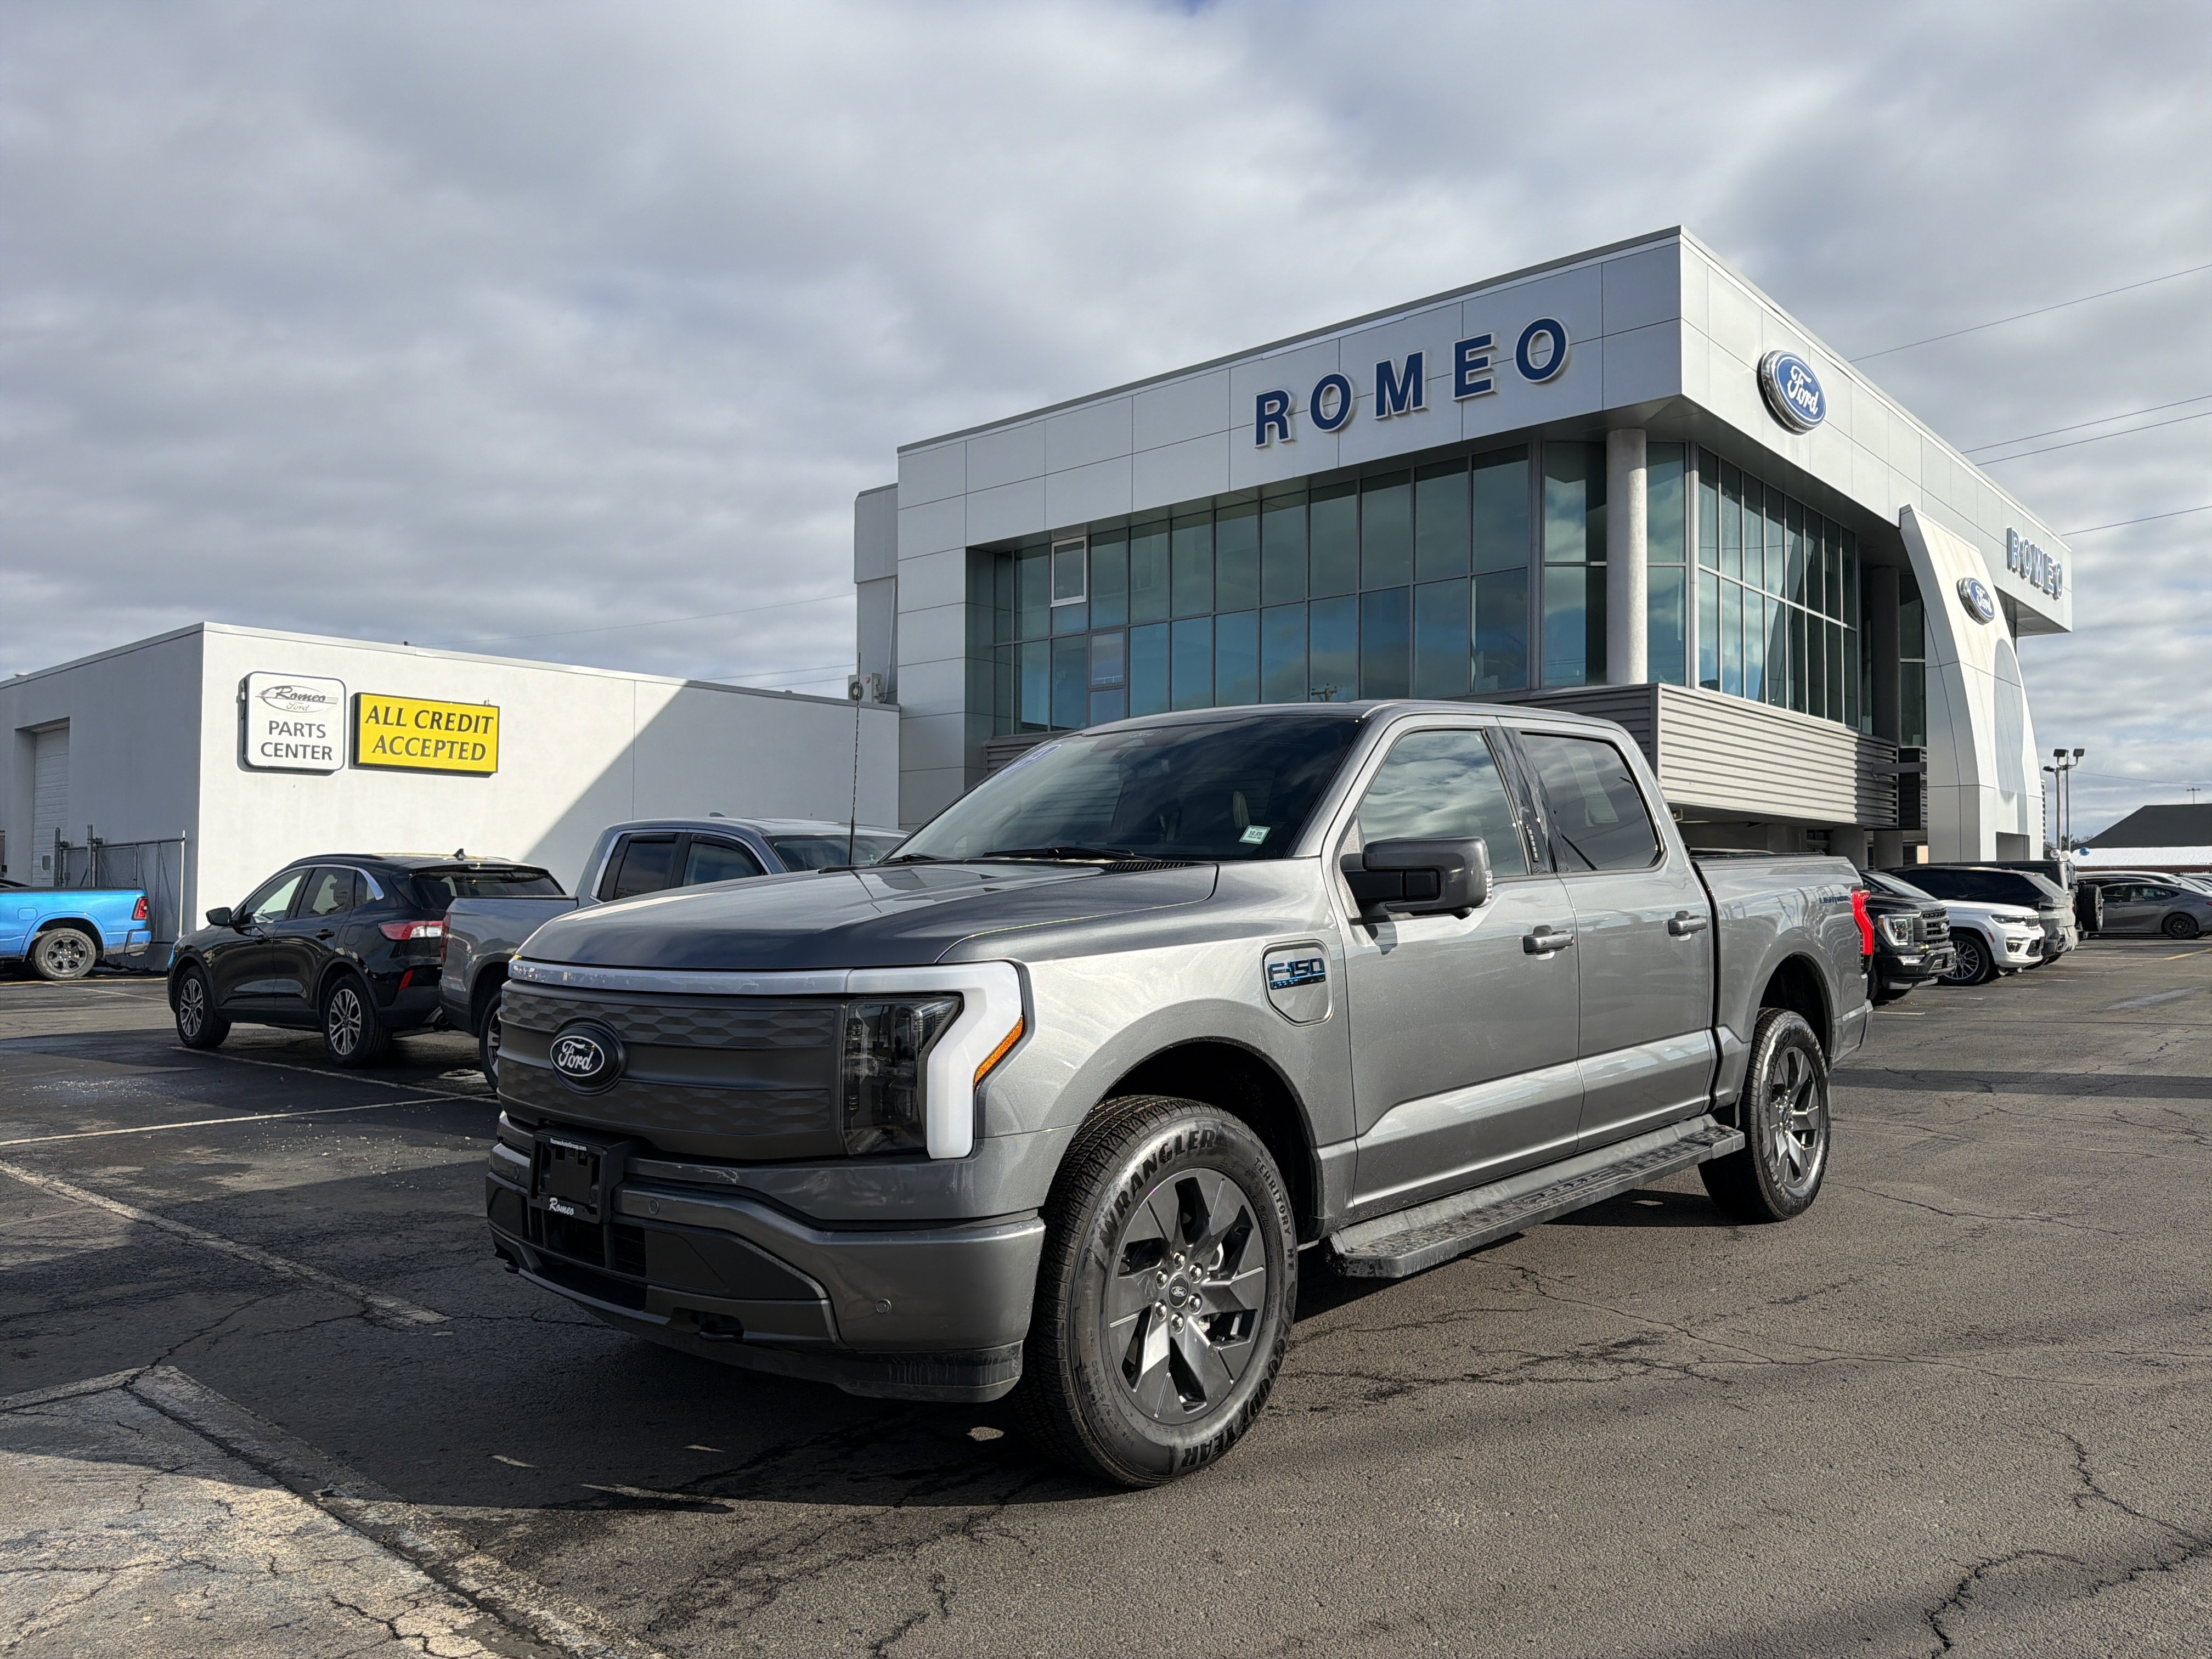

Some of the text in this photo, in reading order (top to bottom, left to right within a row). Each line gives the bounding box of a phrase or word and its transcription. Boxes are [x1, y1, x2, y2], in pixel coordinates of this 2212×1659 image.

[1254, 316, 1570, 449] ROMEO
[1787, 365, 1819, 415] Ford
[2006, 527, 2063, 600] ROMEO
[1975, 585, 1992, 614] Ford
[275, 686, 326, 703] Romeo
[286, 702, 309, 712] Ford
[268, 720, 326, 739] PARTS
[364, 705, 494, 735] ALL CREDIT
[261, 742, 333, 761] CENTER
[371, 735, 487, 761] ACCEPTED
[558, 1040, 594, 1071] Ford
[1099, 1129, 1216, 1248] WRANGLER
[1254, 1157, 1291, 1236] TERRITORY
[549, 1197, 574, 1216] Romeo
